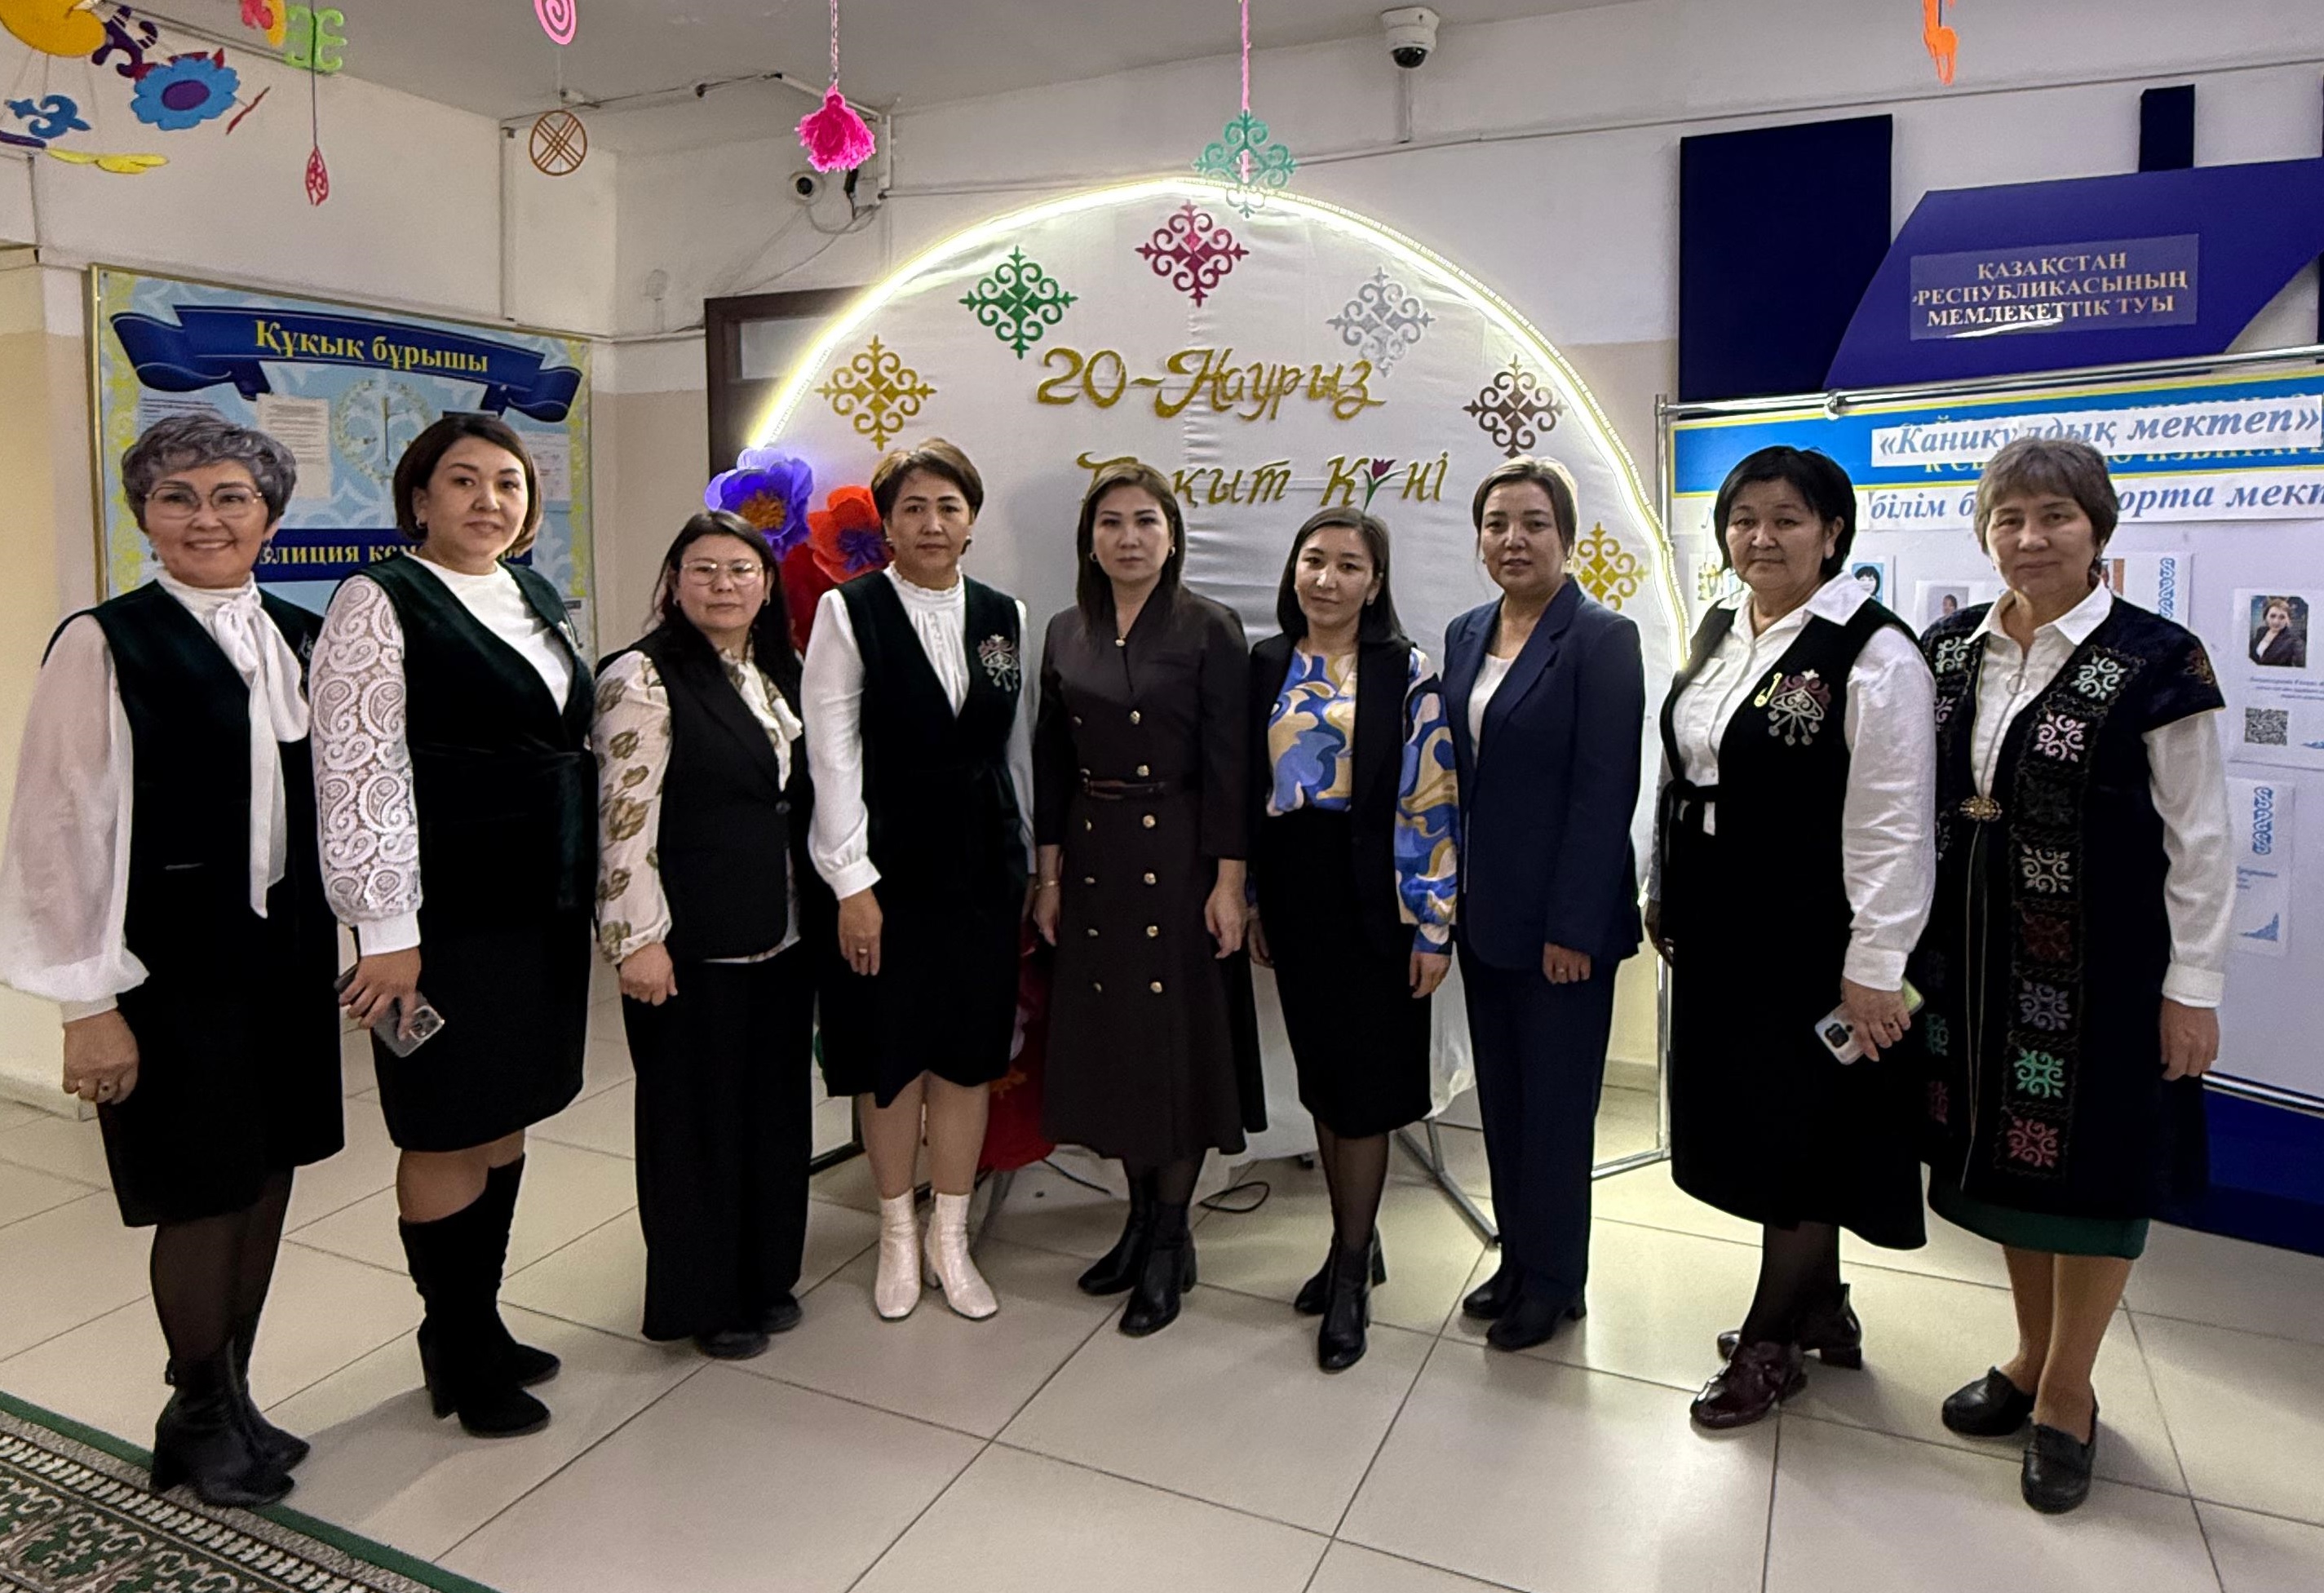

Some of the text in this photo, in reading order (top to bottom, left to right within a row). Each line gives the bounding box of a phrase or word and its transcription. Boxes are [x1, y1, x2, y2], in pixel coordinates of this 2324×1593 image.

[1977, 252, 2127, 281] ҚАЗАҚСТАН
[1926, 294, 2175, 327] МЕМЛЕКЕТТІК ТУЫ
[2126, 407, 2321, 442] мектеп»
[1870, 491, 1946, 520] білім
[2117, 486, 2216, 518] орта
